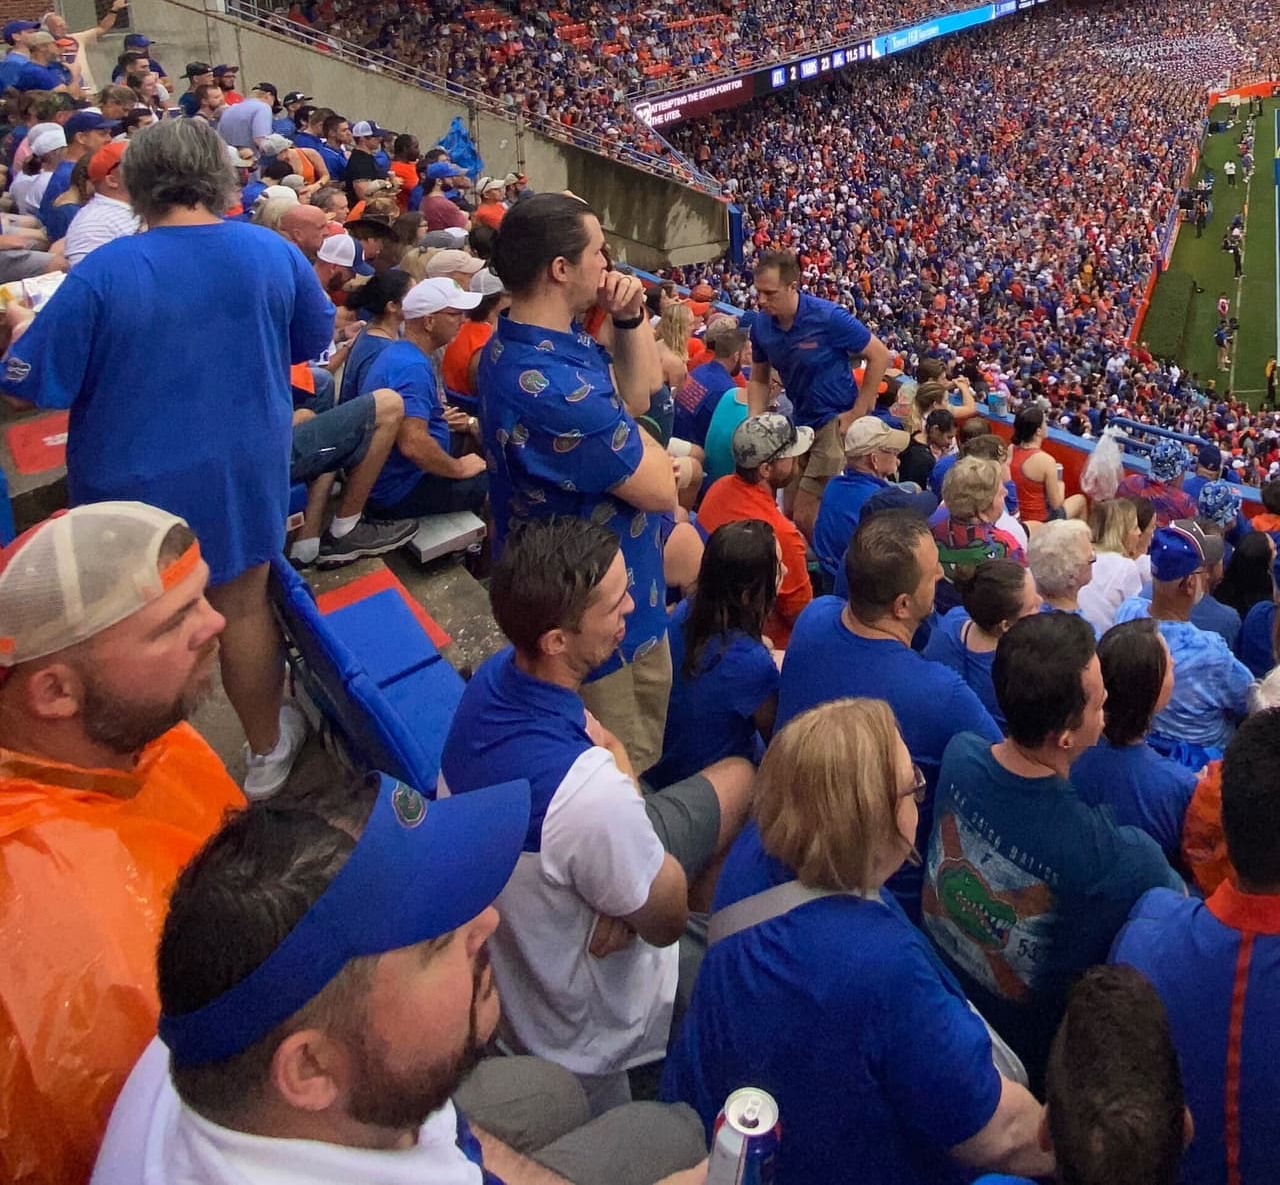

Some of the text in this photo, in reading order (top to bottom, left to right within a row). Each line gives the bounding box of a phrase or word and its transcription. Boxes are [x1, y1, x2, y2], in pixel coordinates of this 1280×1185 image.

[790, 66, 797, 80] 2
[821, 57, 830, 70] 23
[846, 49, 858, 63] 11.5
[650, 79, 743, 114] ATTEMPTING THE EXTRA POINT FOR
[650, 112, 665, 127] THE
